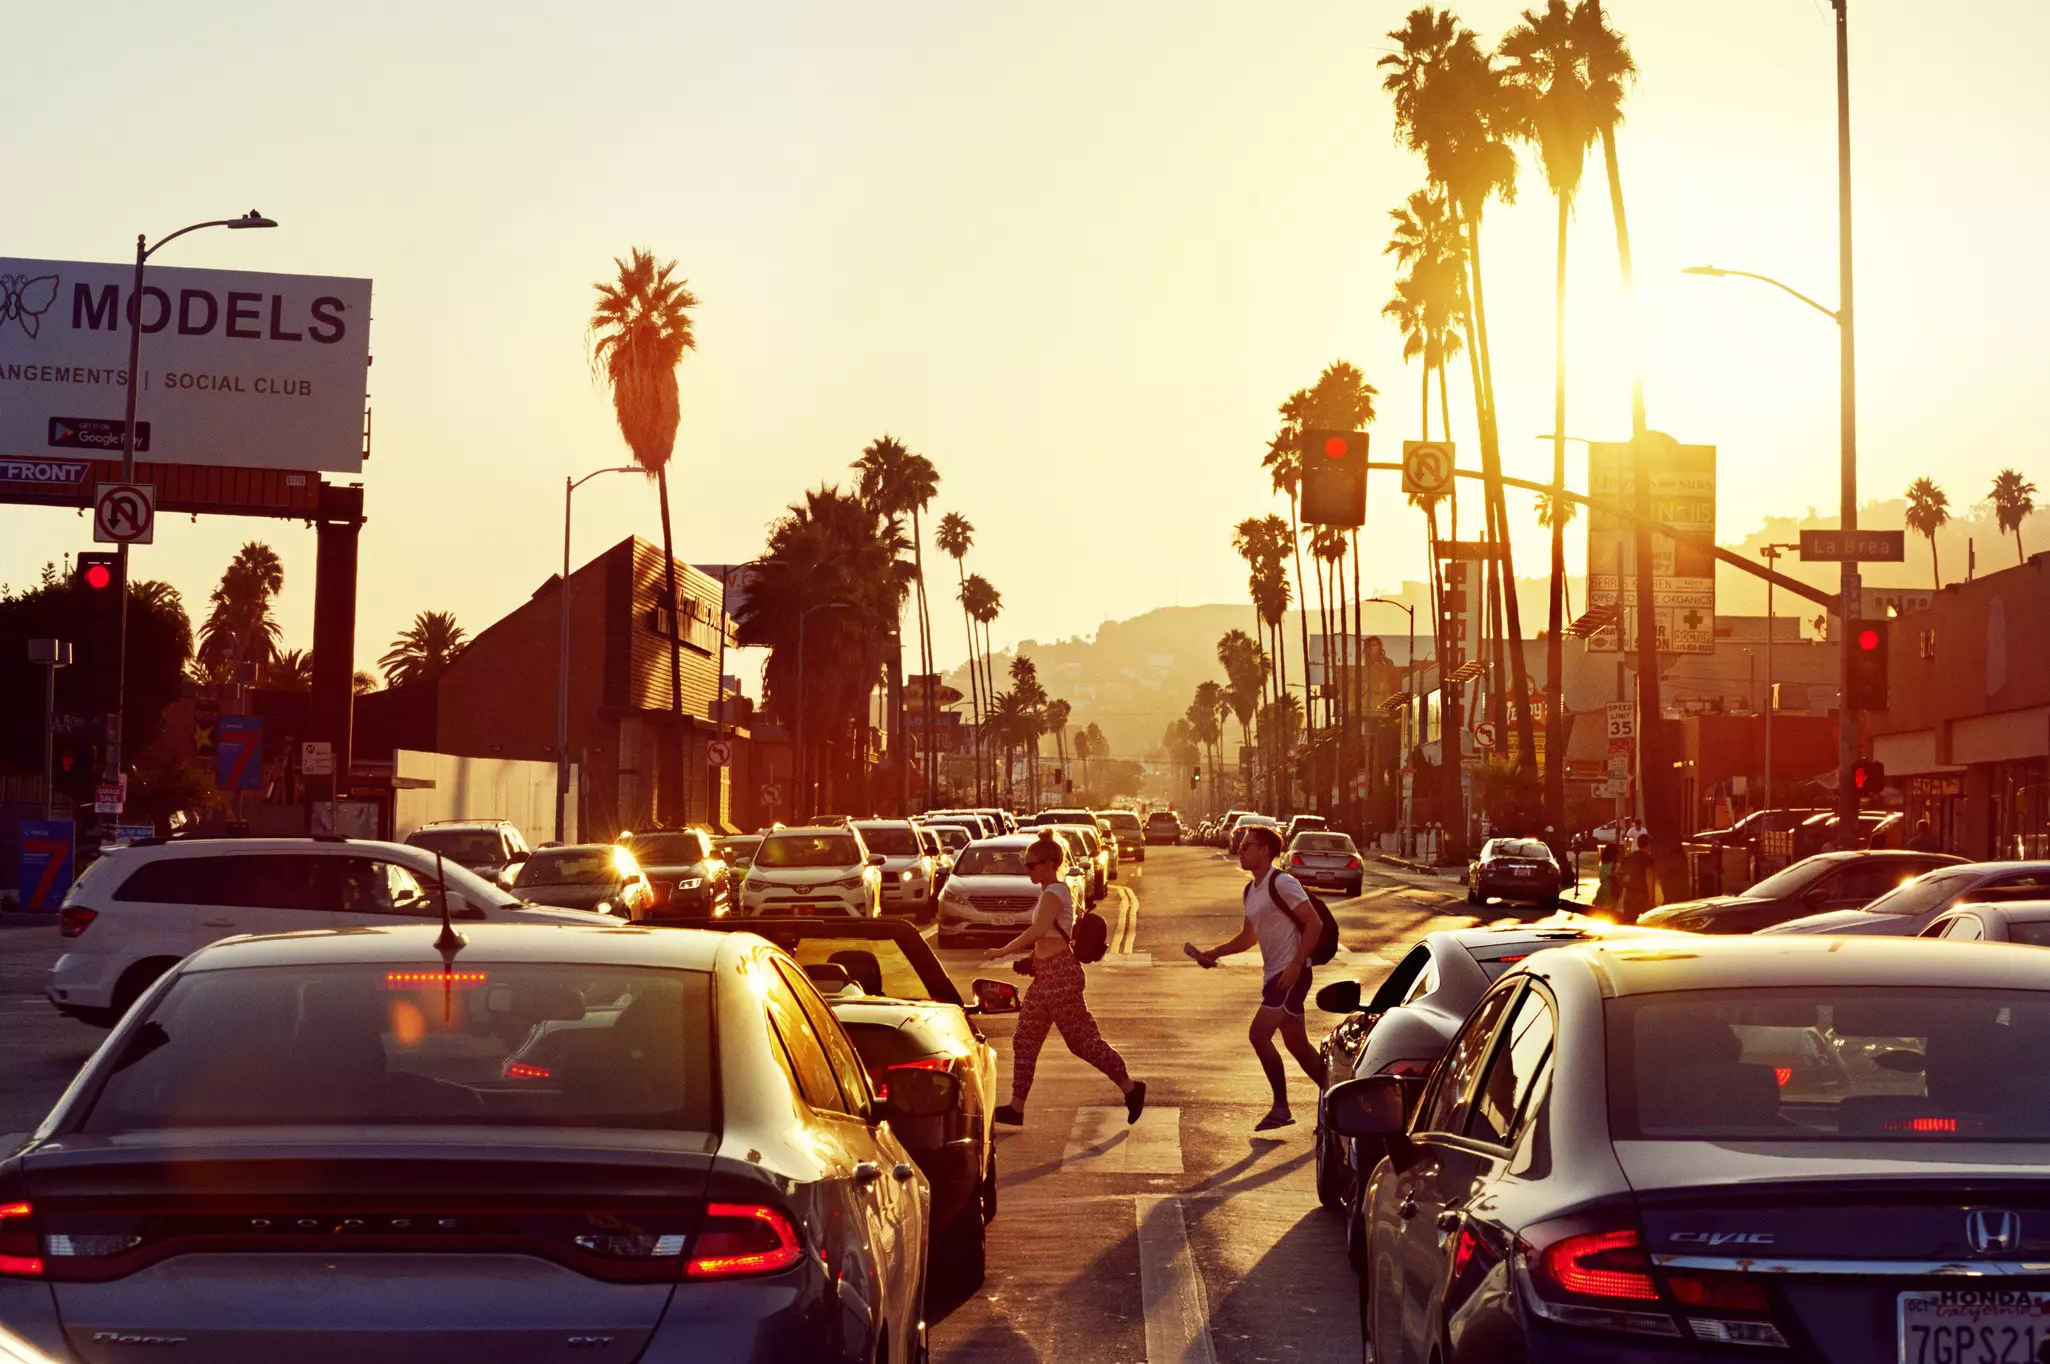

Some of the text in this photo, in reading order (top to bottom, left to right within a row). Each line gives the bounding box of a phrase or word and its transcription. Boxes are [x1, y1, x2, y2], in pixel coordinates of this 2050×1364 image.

[71, 283, 347, 344] MODELS
[165, 372, 245, 393] SOCIAL
[255, 377, 312, 396] CLUB
[79, 431, 119, 446] Google
[1814, 539, 1890, 554] La Brea
[1663, 594, 1712, 605] ORGANICS
[1675, 631, 1712, 643] DOCTOR
[1610, 721, 1632, 735] 35
[252, 1218, 458, 1228] DODGE
[1669, 1232, 1775, 1246] CIVIC
[1941, 1290, 2032, 1306] HONDA
[1911, 1325, 2050, 1364] 7GPS21
